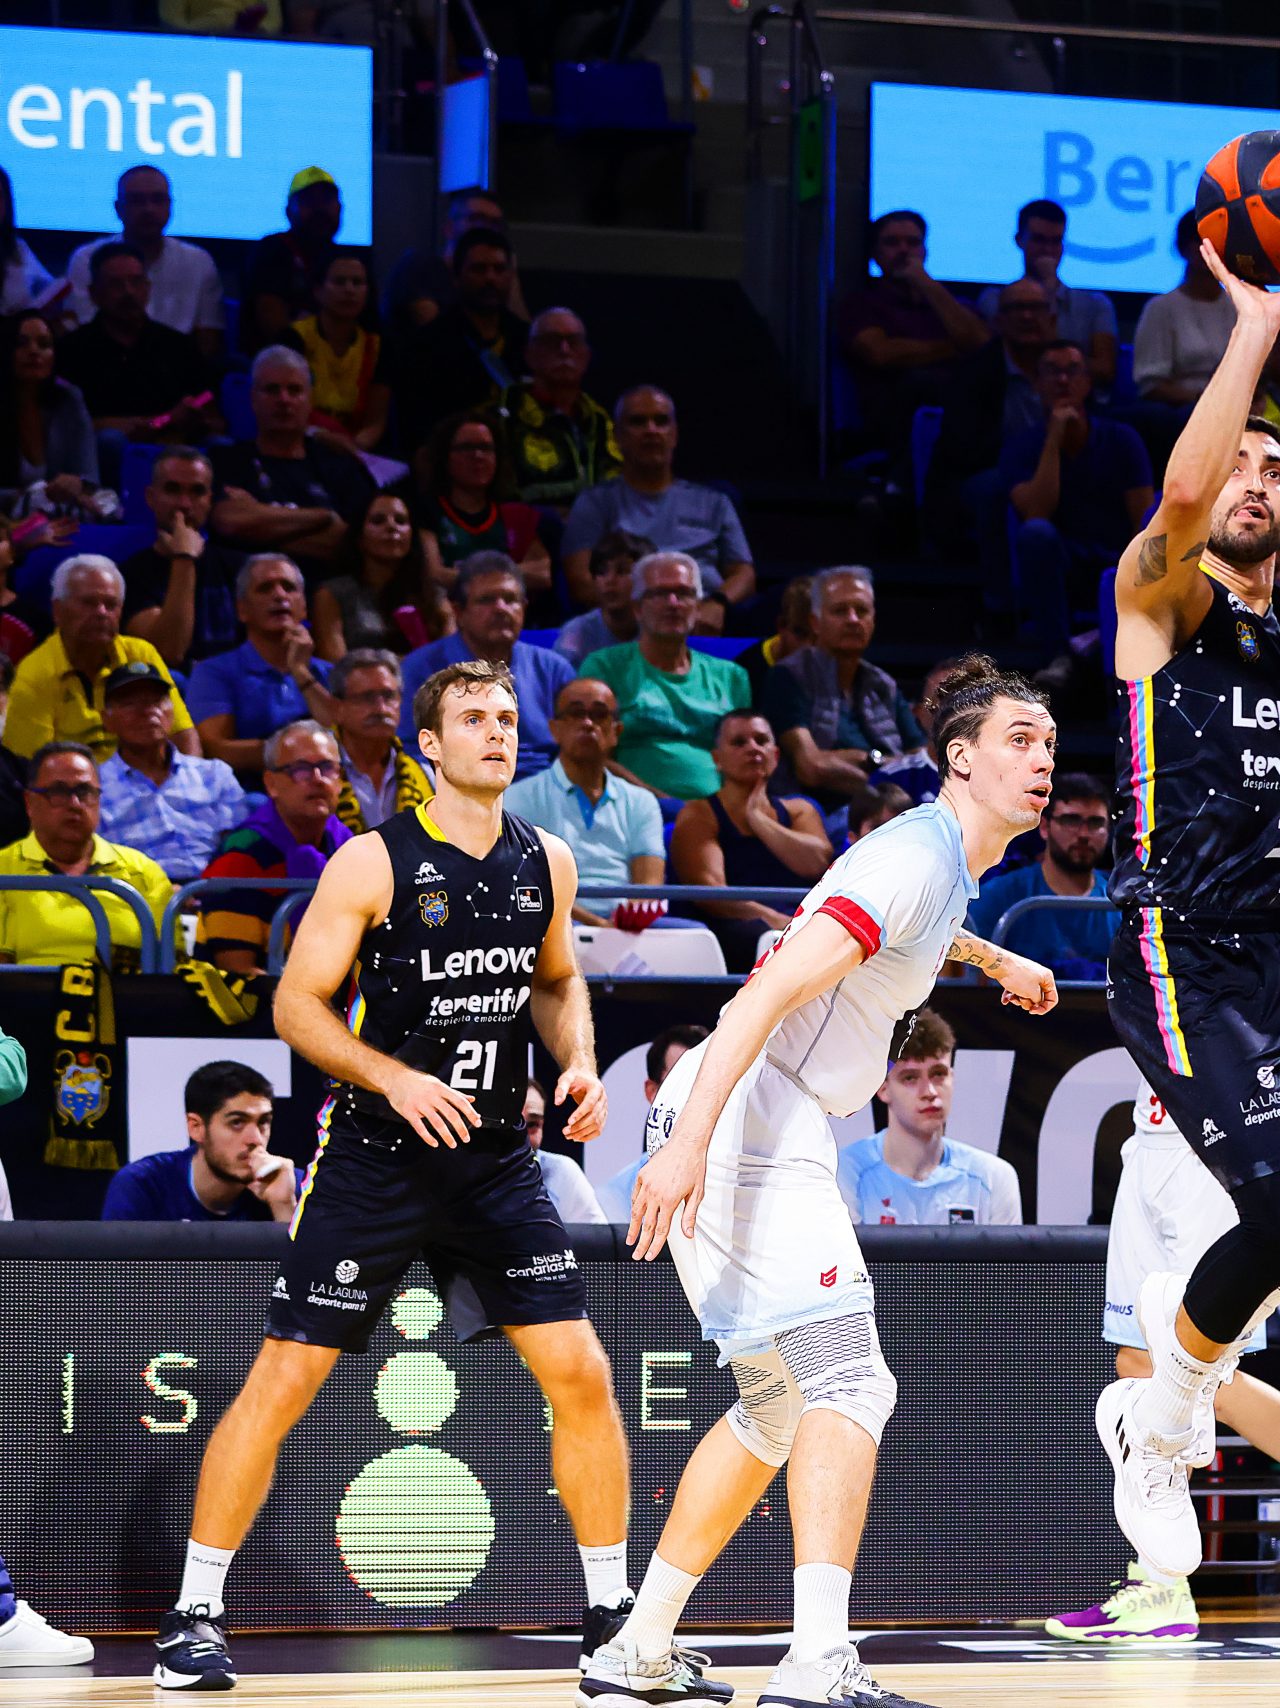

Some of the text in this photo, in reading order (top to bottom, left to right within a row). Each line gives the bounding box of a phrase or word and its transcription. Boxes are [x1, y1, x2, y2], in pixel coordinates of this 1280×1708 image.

[7, 70, 243, 159] ental
[474, 1013, 513, 1024] emocion
[451, 1040, 498, 1090] 21
[1239, 1098, 1259, 1113] LA
[506, 1262, 565, 1278] Canarias
[310, 1281, 368, 1301] LA LAGUNA
[307, 1294, 342, 1308] deporte
